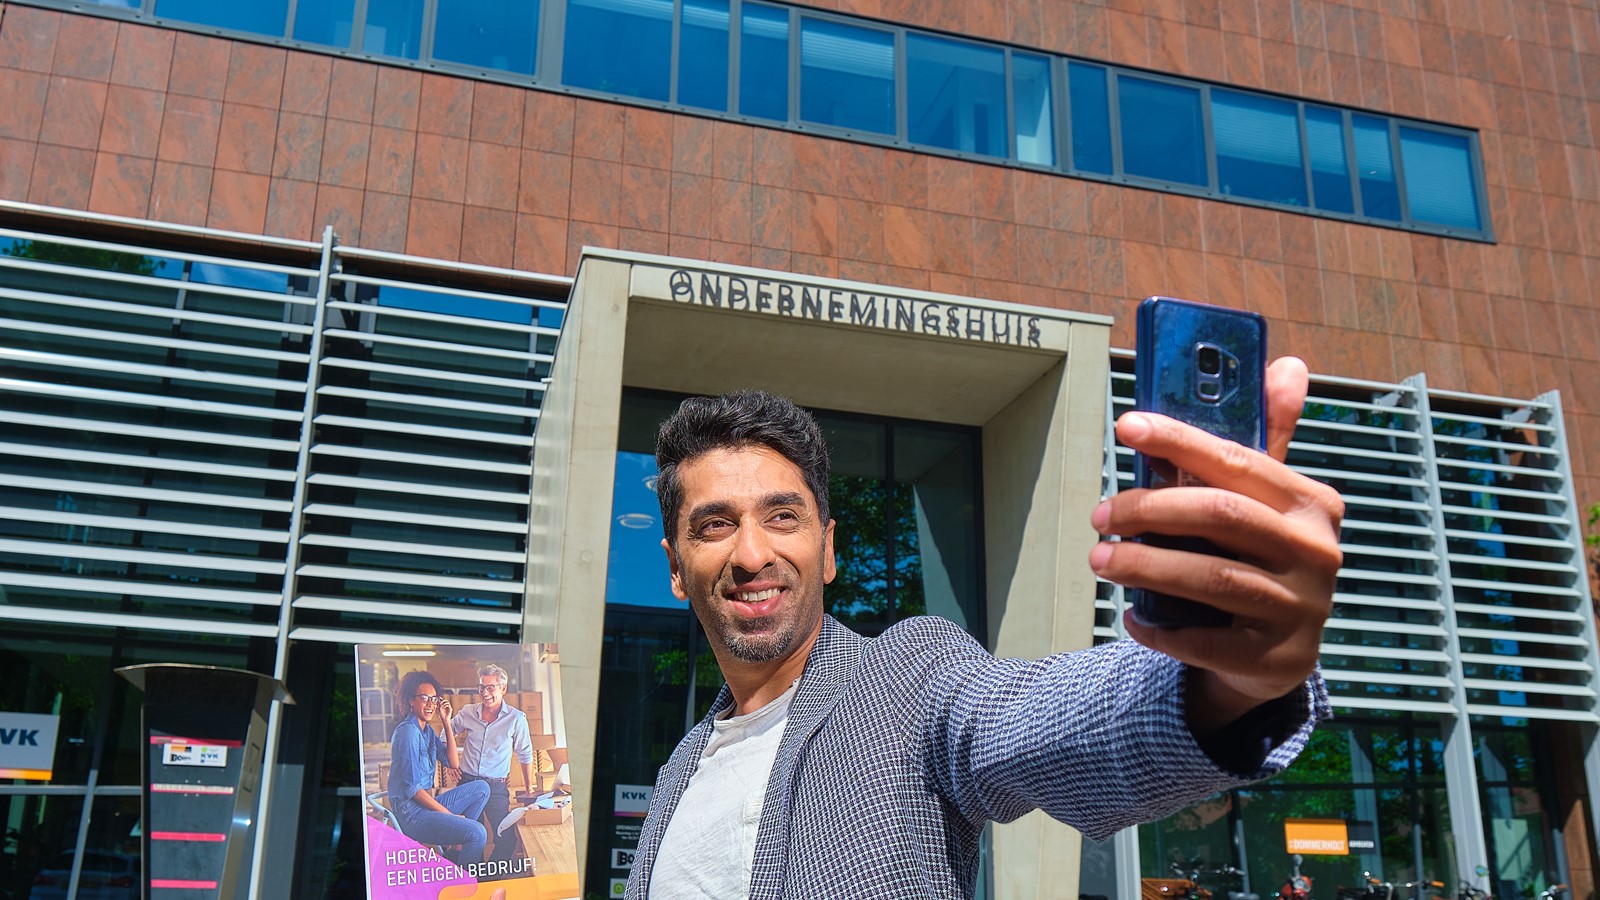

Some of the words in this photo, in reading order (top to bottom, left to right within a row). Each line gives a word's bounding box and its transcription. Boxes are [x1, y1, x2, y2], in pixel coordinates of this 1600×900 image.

[669, 270, 1041, 344] ONDERNEMINGSHUIS
[0, 727, 39, 747] VK
[622, 791, 646, 800] KVK
[385, 847, 442, 866] HOERA,
[386, 871, 418, 887] EEN
[421, 864, 464, 883] EIGEN
[467, 857, 537, 878] BEDRIJF!
